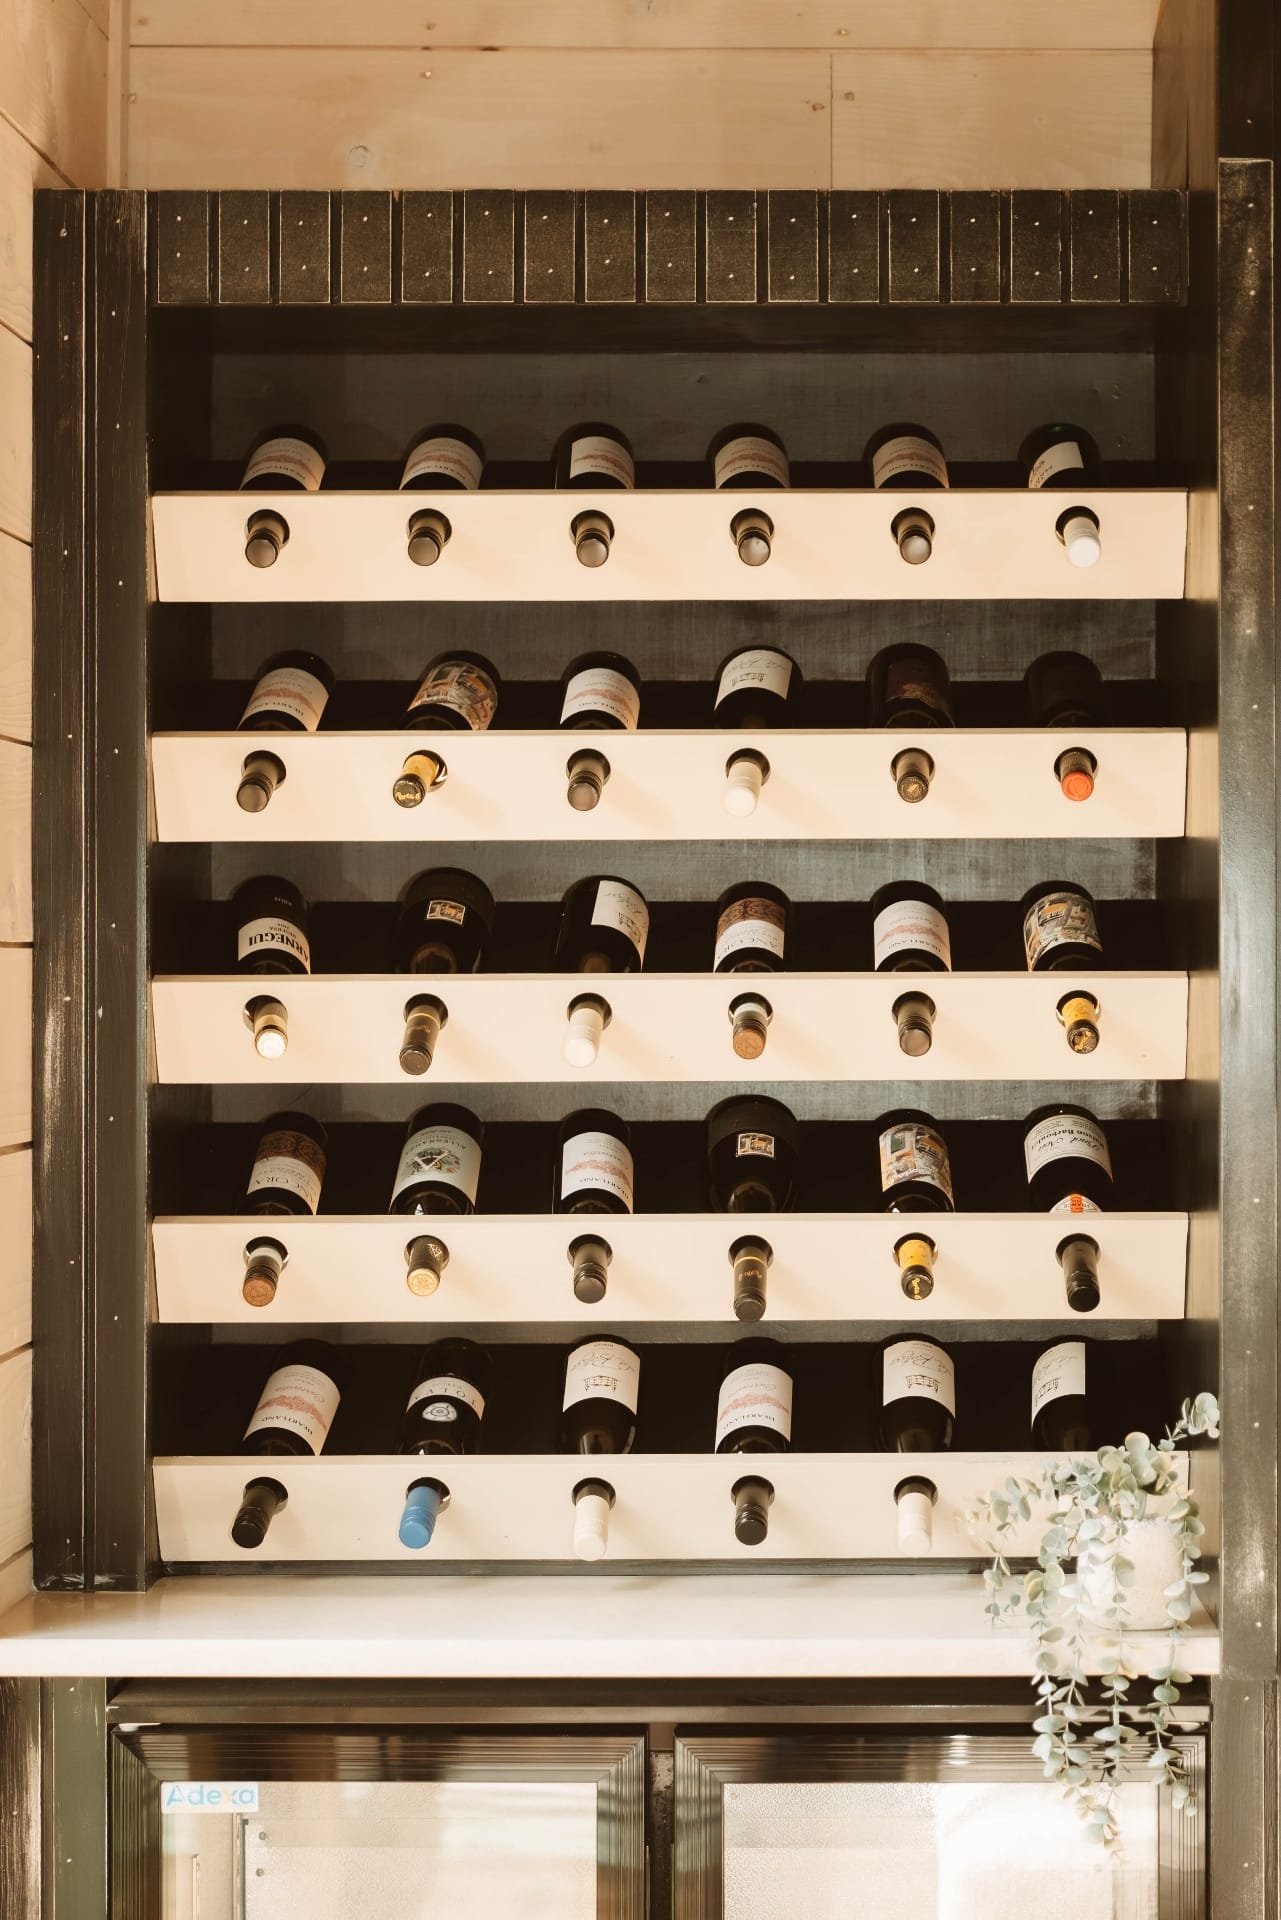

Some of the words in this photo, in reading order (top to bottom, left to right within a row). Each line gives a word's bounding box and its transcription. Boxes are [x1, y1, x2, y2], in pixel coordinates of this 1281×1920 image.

[888, 939, 941, 952] HEARTLAND
[580, 1177, 630, 1200] HEARTLAND
[261, 1415, 313, 1435] HEARTLAND
[724, 1413, 776, 1430] HEARTLAND
[166, 1784, 255, 1807] Adexa
